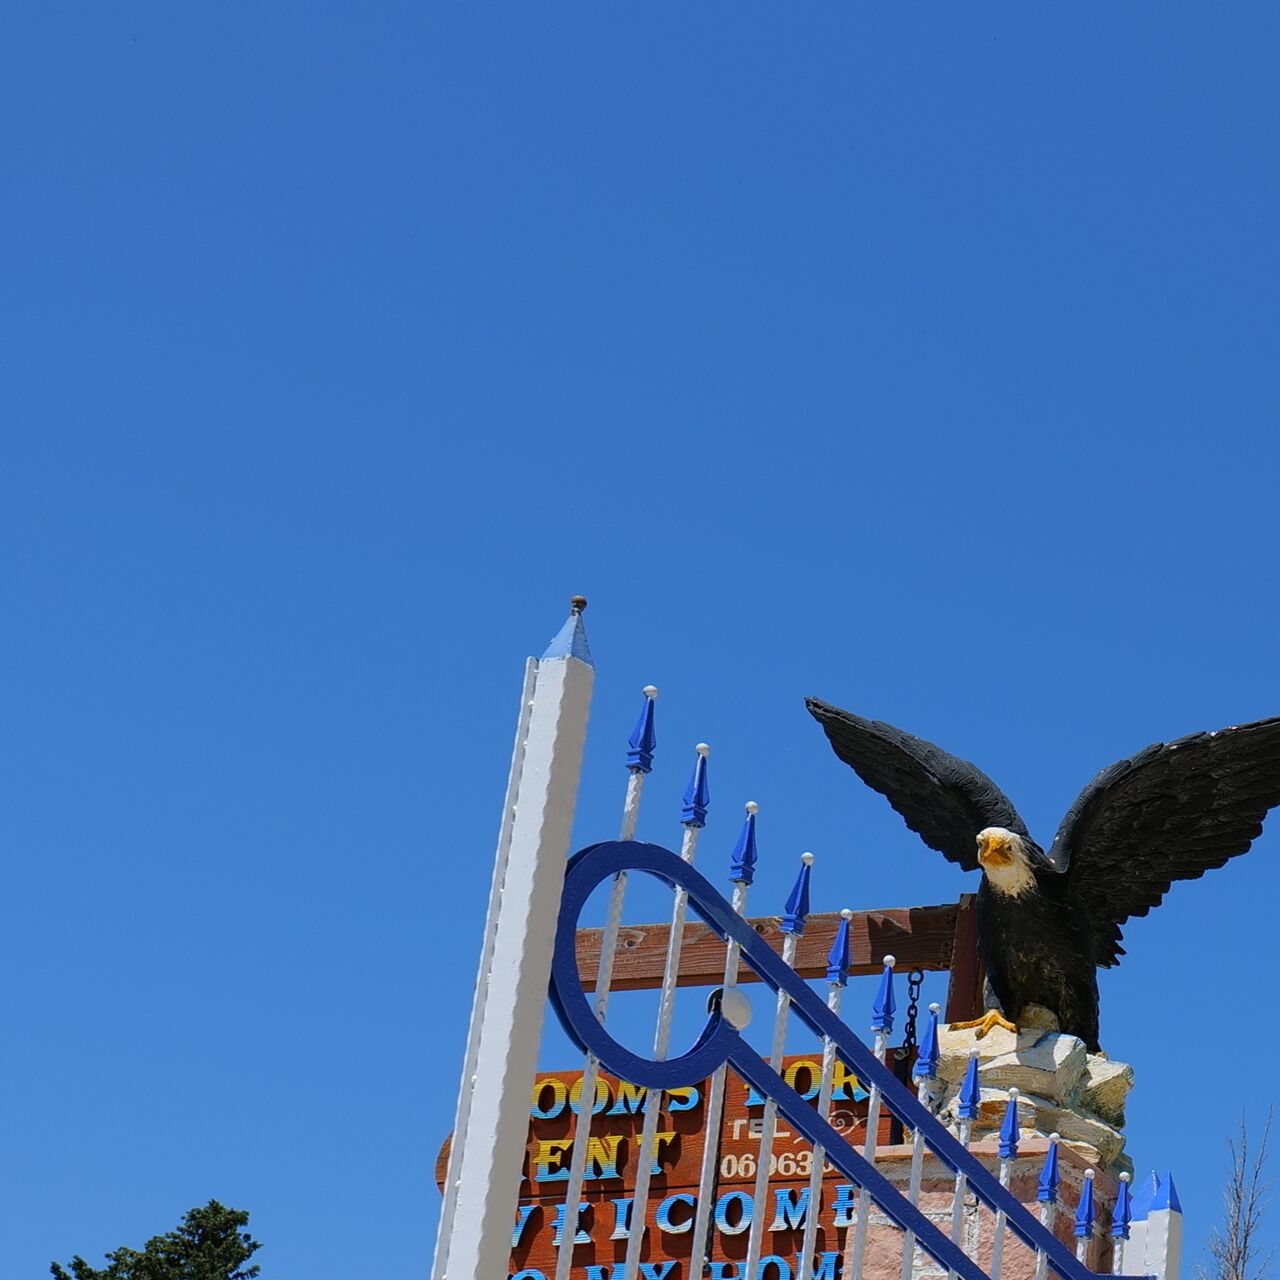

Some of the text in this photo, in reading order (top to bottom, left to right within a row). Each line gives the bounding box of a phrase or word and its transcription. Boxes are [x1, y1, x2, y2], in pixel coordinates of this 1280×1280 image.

[530, 1076, 700, 1119] OOMS
[728, 1118, 791, 1140] TEL
[521, 1131, 677, 1182] ENT
